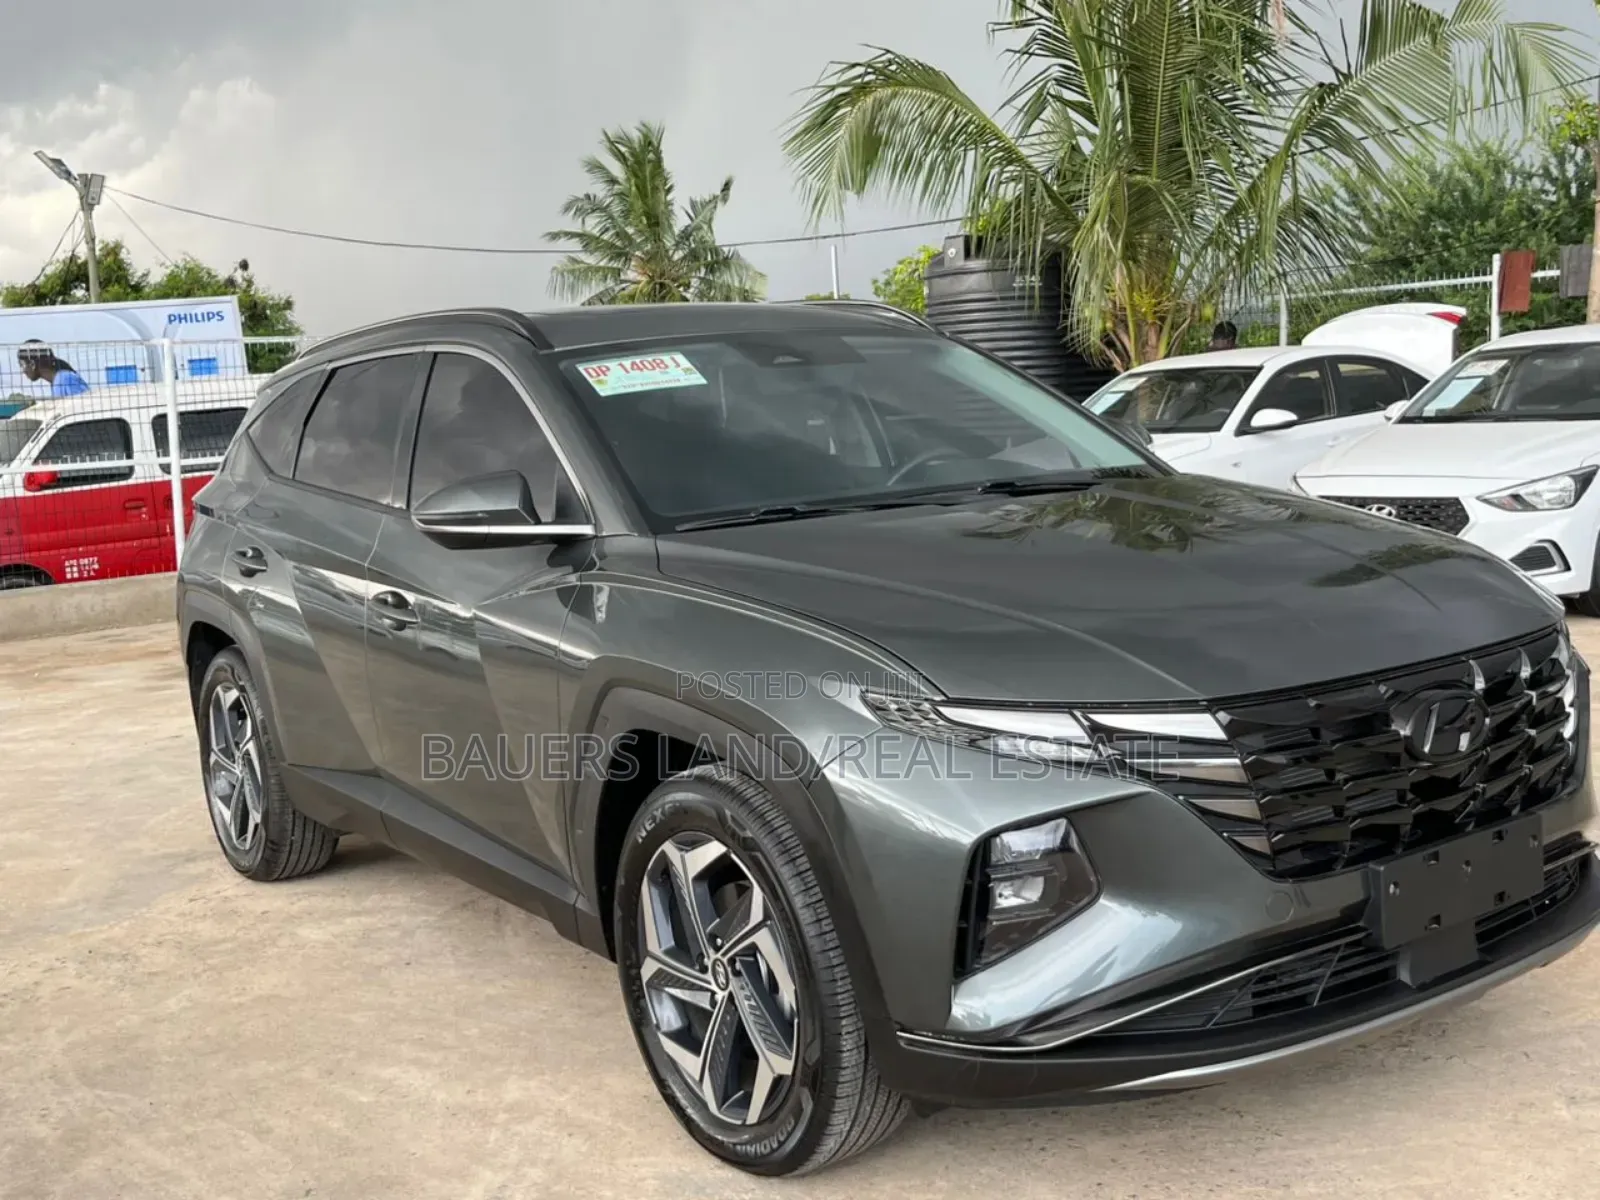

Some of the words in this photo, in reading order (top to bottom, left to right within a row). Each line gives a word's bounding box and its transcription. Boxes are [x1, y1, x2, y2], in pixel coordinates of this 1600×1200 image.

[168, 310, 225, 324] PHILIPS
[584, 365, 611, 379] DP
[618, 358, 669, 374] 1408
